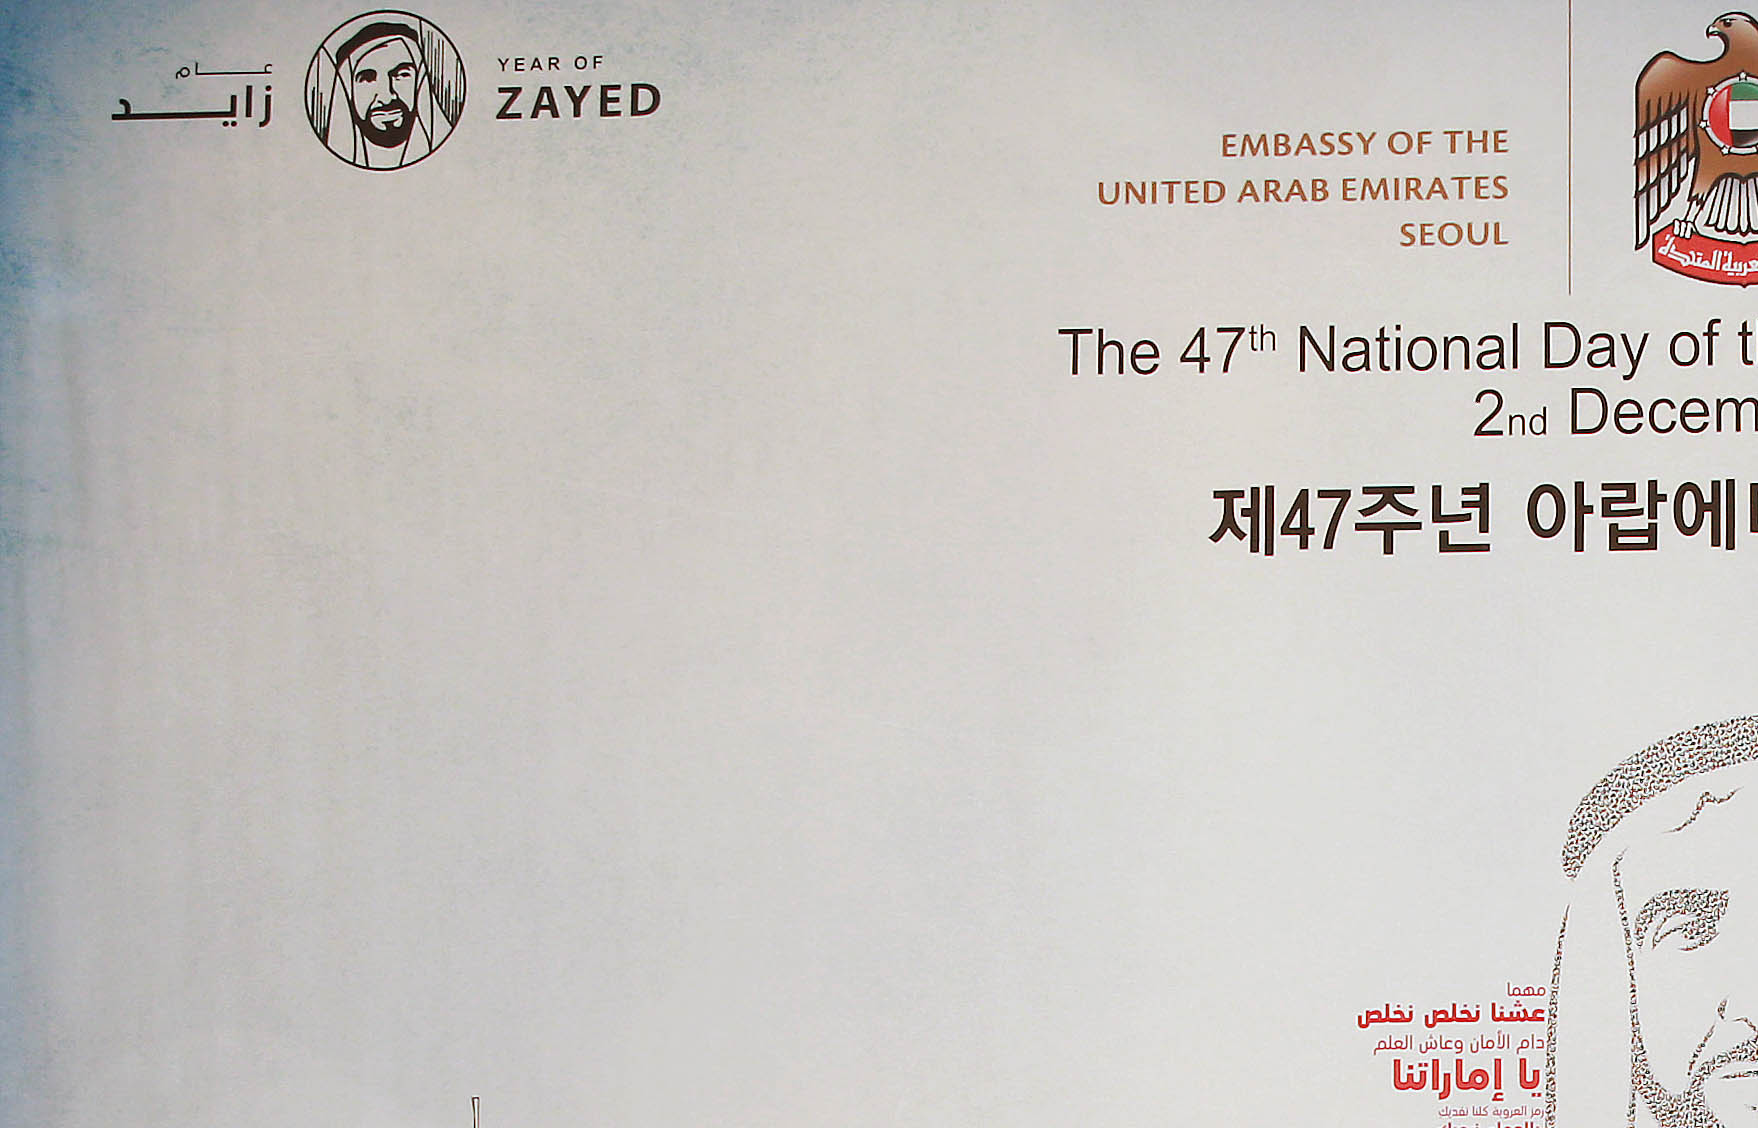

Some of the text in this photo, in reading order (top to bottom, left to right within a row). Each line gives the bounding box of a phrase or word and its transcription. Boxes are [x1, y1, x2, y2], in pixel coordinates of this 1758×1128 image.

[176, 62, 272, 79] عام
[498, 56, 603, 71] YEAR OF
[111, 85, 272, 127] زايد
[496, 83, 660, 119] ZAYED
[1223, 130, 1508, 157] EMBASSY OF THE
[1099, 176, 1508, 205] UNITED ARAB EMIRATES
[1400, 222, 1508, 246] SEOUL
[1058, 329, 1159, 375] The
[1300, 323, 1518, 372] National
[1544, 322, 1649, 380] Day
[1670, 319, 1721, 366] of
[1474, 389, 1546, 436] 2nd
[1208, 483, 1490, 556] 제47주년
[1508, 983, 1546, 996] مهما
[1358, 1000, 1544, 1028] عشنا نخلص نخلص
[1374, 1031, 1544, 1055] دام الأمان وعاش العلم
[1394, 1058, 1541, 1101] يا إماراتنا
